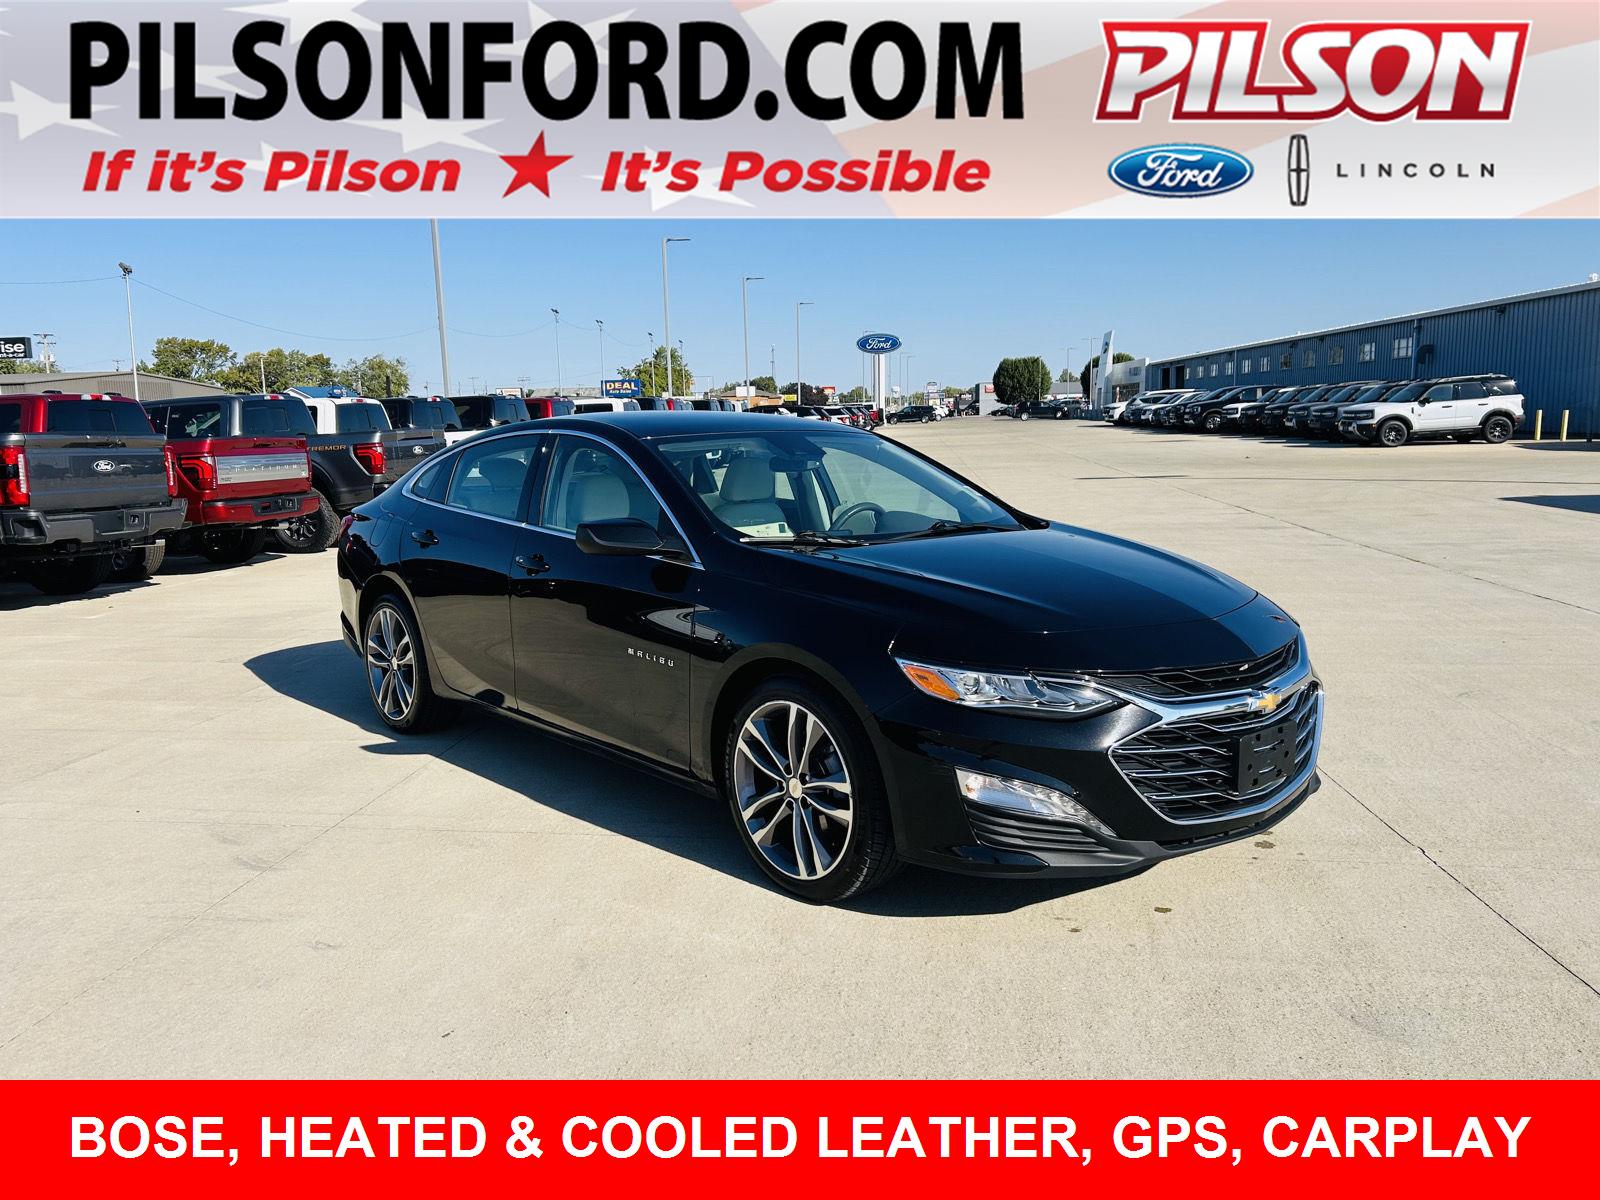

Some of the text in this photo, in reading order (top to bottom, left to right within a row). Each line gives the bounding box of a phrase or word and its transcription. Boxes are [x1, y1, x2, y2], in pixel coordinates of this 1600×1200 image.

[865, 337, 893, 349] Ford
[606, 382, 639, 391] DEAL
[627, 647, 674, 667] MALIBU
